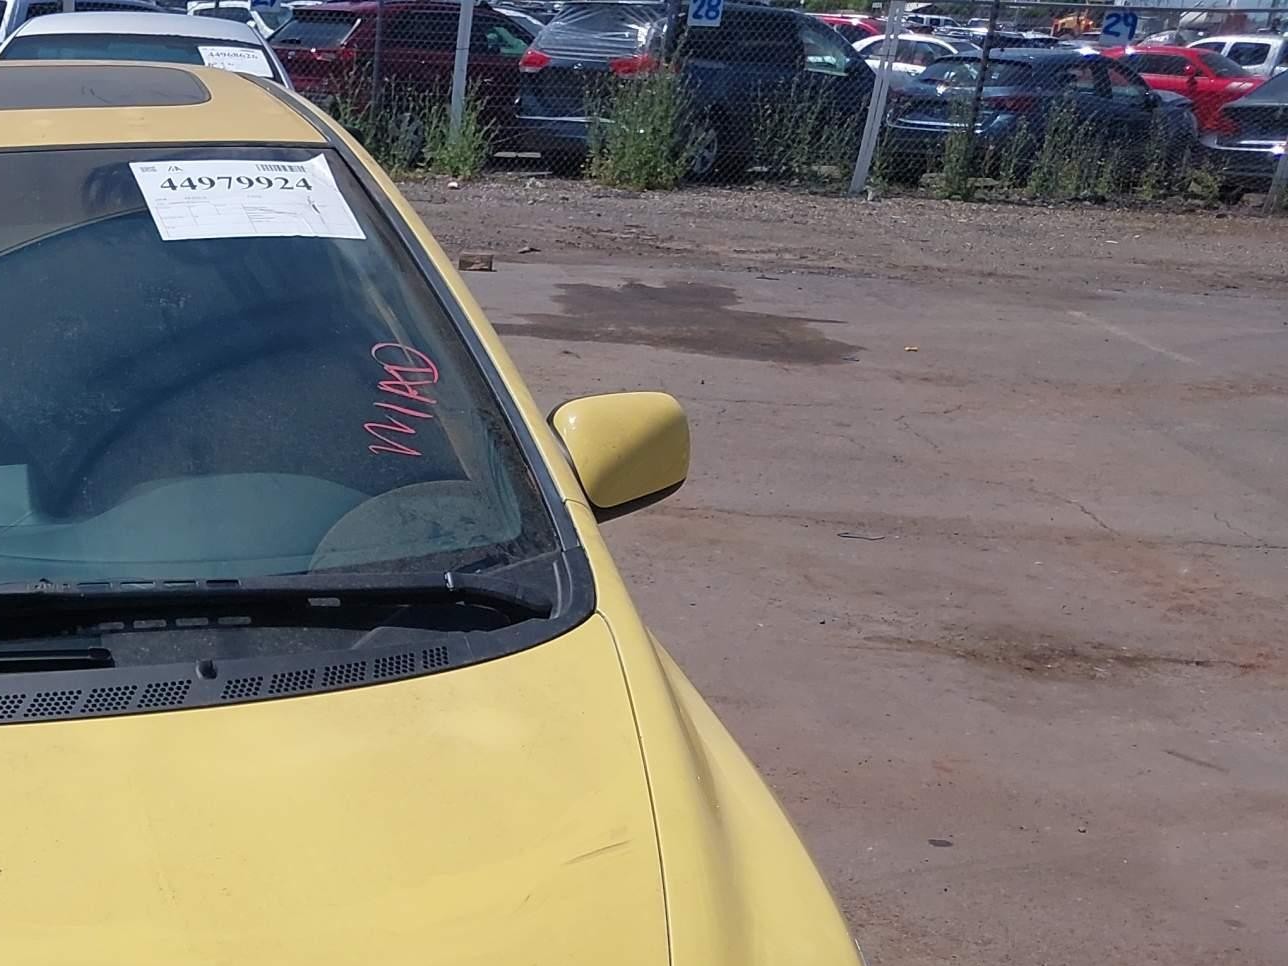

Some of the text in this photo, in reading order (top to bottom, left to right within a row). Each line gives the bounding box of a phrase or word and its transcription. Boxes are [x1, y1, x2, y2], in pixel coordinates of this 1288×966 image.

[692, 0, 721, 20] 28
[1103, 12, 1137, 40] 29
[160, 175, 313, 191] 44979924
